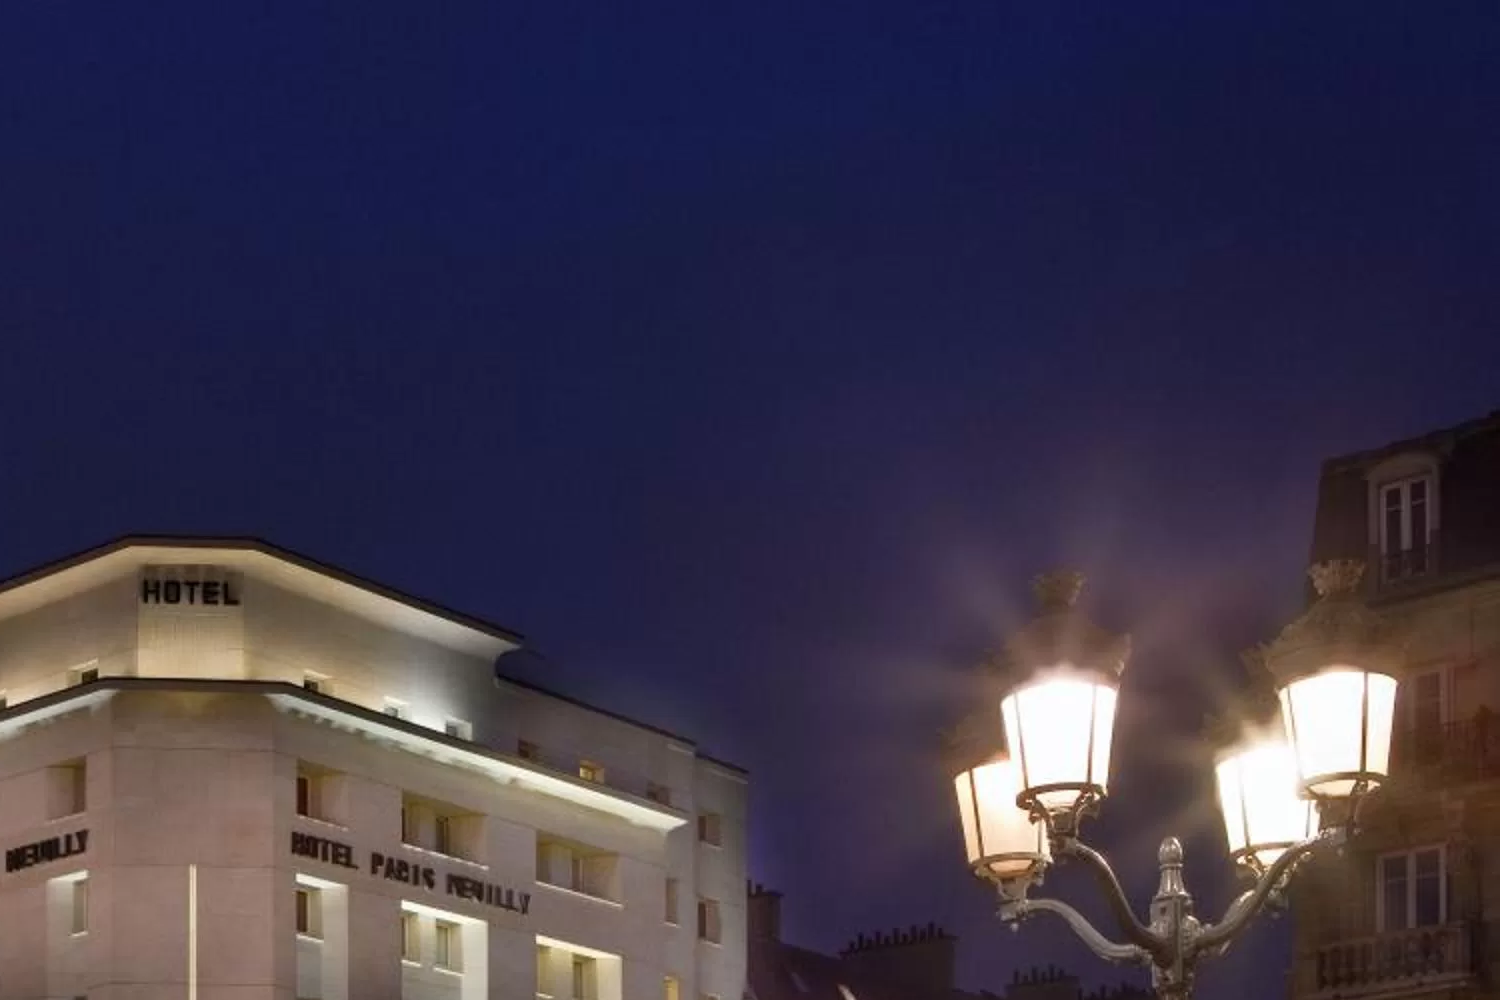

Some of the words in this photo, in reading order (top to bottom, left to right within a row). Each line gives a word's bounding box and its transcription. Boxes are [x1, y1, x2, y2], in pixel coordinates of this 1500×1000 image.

[143, 579, 240, 606] HOTEL
[5, 829, 90, 873] NEUILLY
[291, 831, 359, 870] HOTEL
[371, 852, 436, 889] PARIS
[446, 873, 531, 915] NEUILLY
